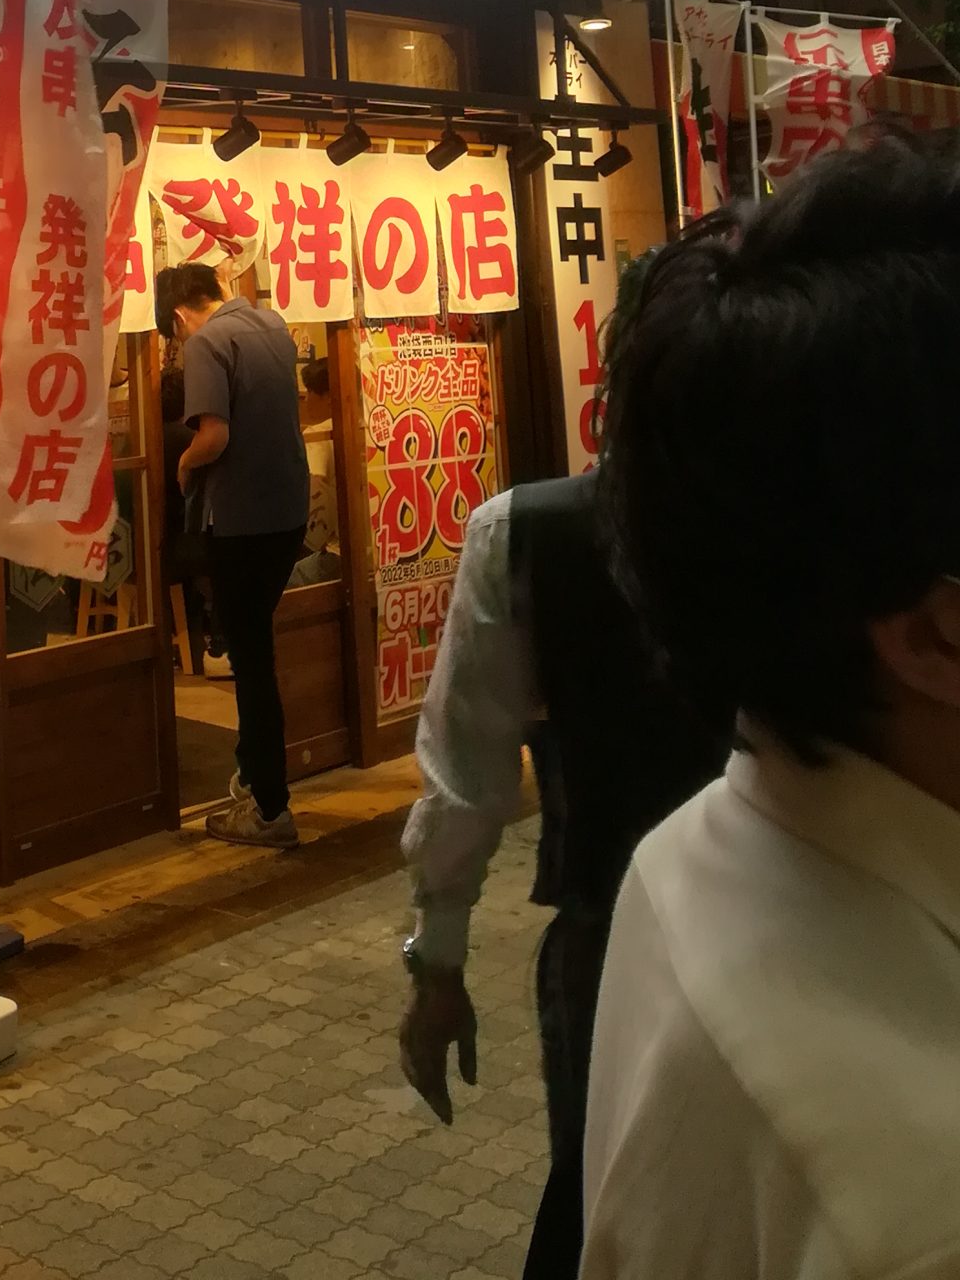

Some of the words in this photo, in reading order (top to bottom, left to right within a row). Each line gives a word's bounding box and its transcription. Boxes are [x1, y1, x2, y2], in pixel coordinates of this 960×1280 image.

[6, 194, 90, 506] 発祥の店
[377, 359, 482, 405] ドリンク全品
[382, 404, 489, 558] 88
